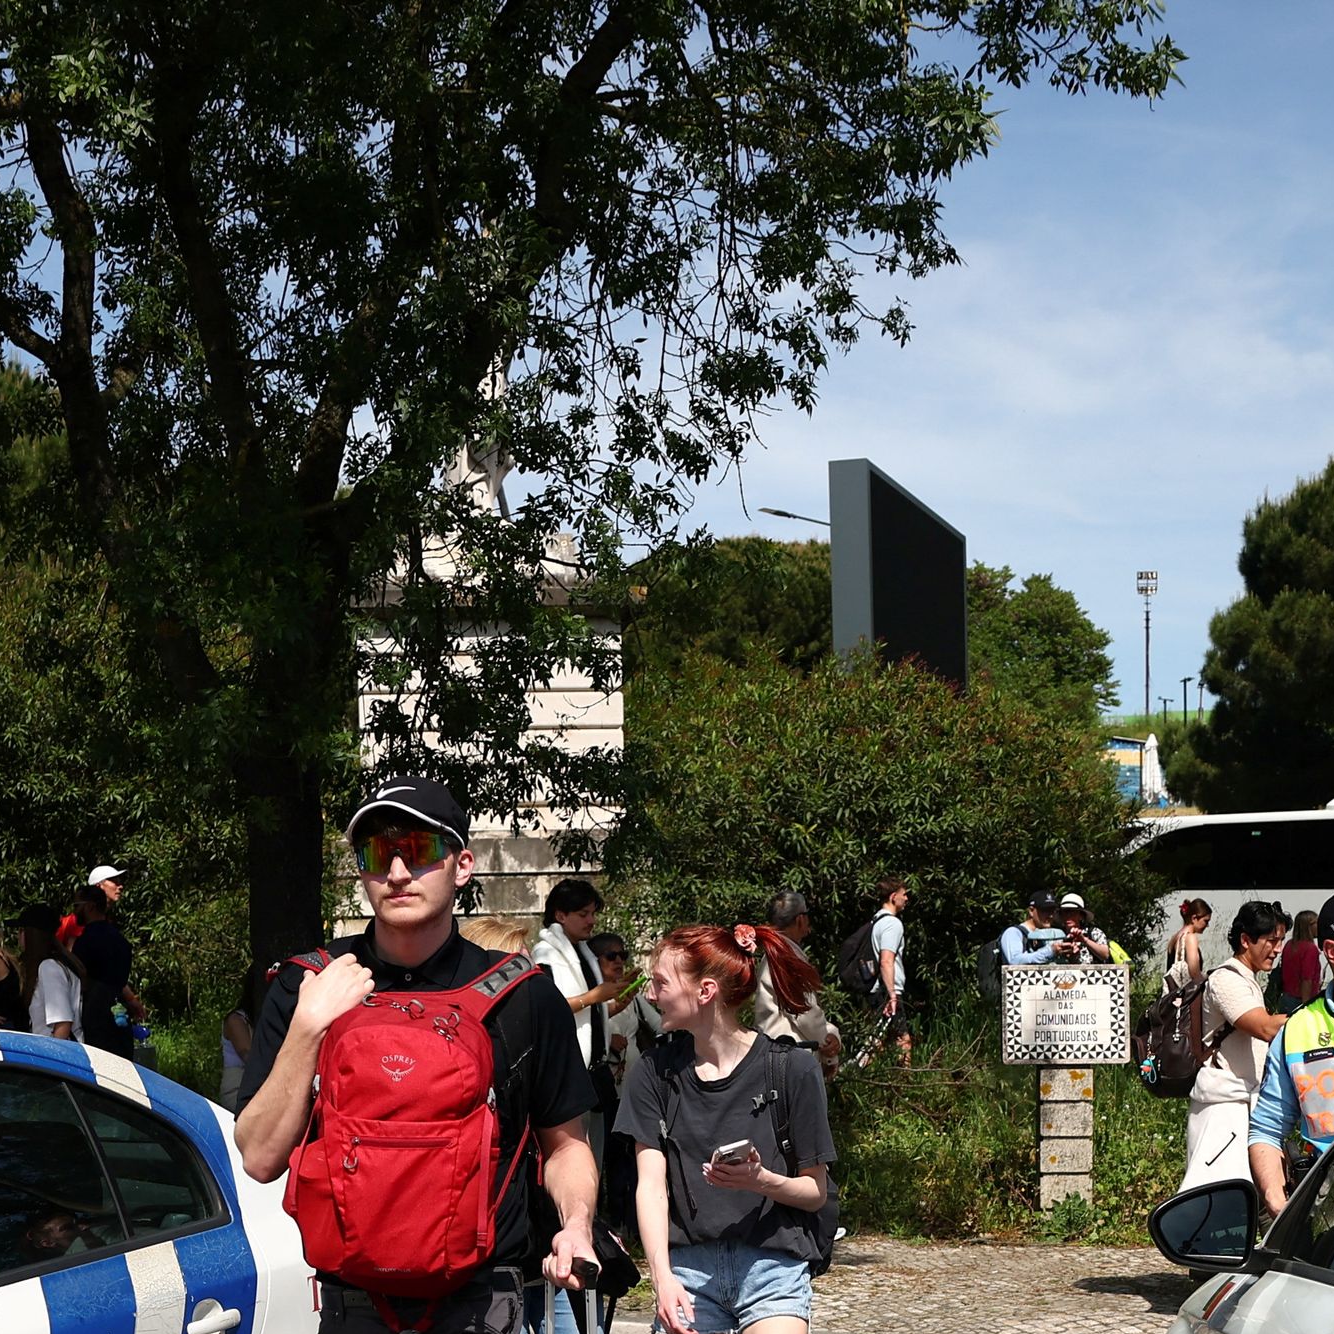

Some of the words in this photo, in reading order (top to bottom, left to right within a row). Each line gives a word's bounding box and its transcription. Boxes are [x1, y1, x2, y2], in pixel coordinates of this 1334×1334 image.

[1043, 990, 1087, 1000] ALAMEDA
[1058, 1001, 1074, 1010] DAS
[1035, 1013, 1097, 1026] COMUNIDADES
[1034, 1030, 1098, 1042] PORTUGUESAS
[381, 1054, 416, 1065] OSPREY
